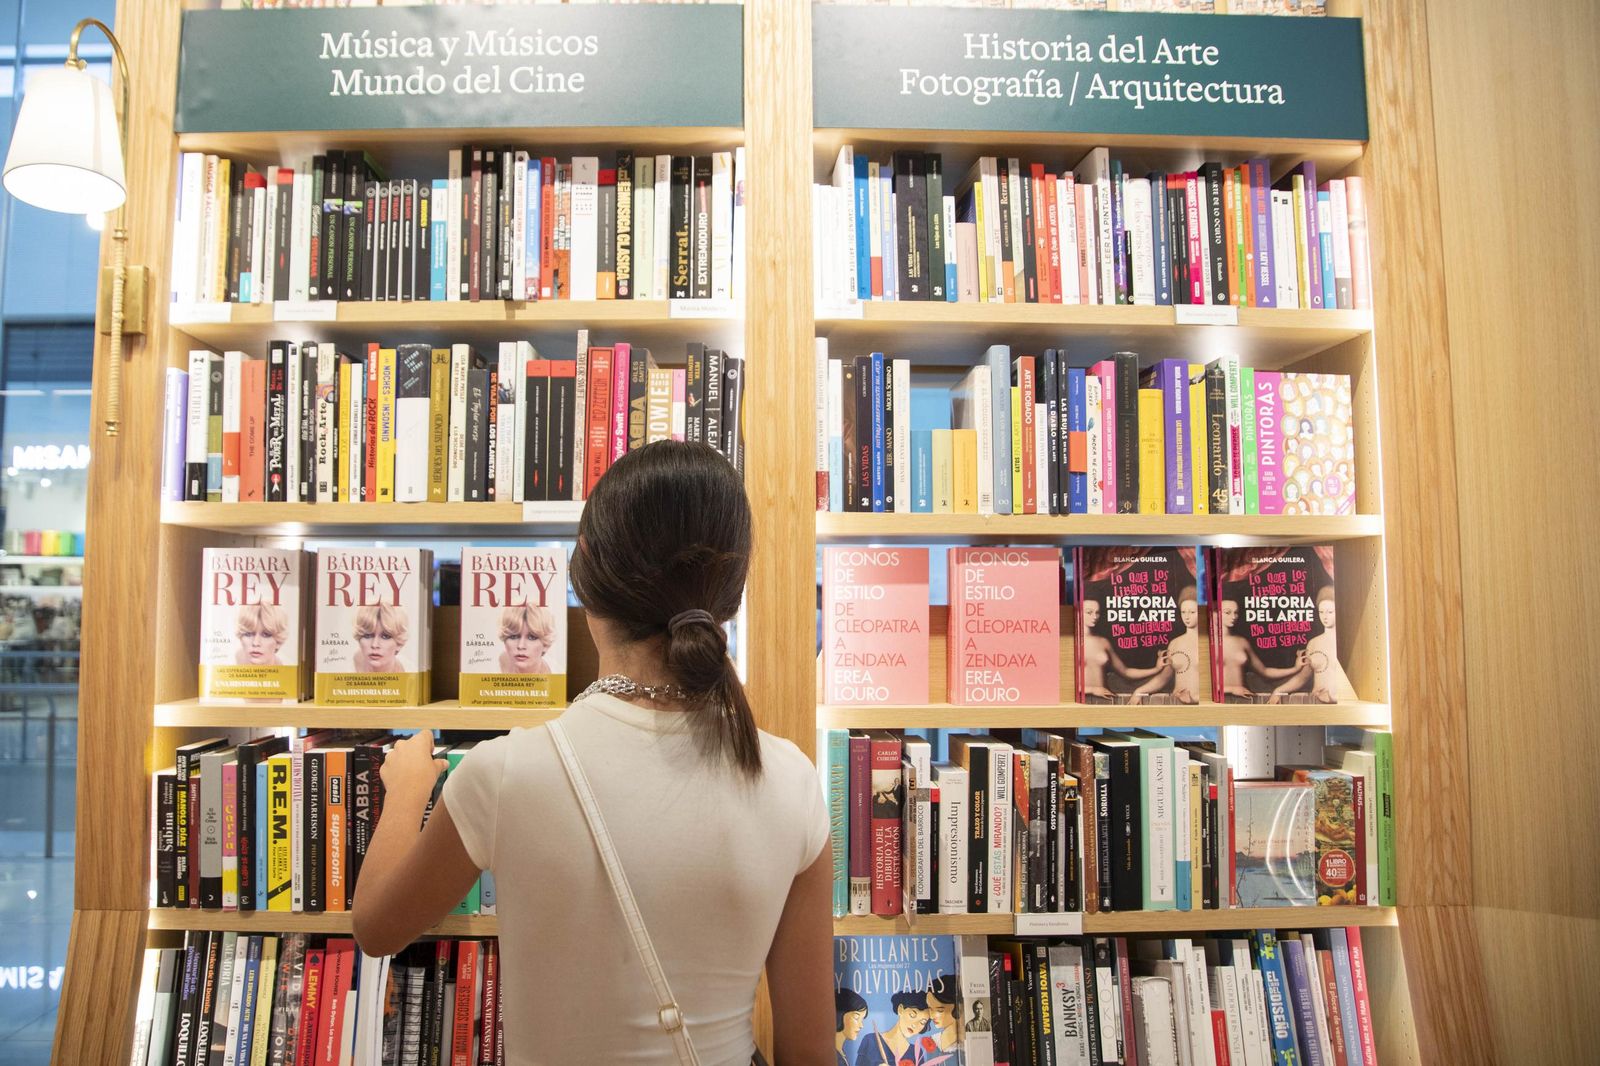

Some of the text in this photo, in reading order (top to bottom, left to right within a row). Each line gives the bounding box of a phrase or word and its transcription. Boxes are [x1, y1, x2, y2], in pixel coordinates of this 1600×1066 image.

[319, 28, 599, 67] Música y Músicos
[964, 32, 1220, 64] Historia del Arte
[329, 64, 586, 97] Mundo del Cine
[899, 67, 1062, 105] Fotografía
[1086, 73, 1284, 108] Arquitectura
[698, 212, 708, 286] EXTREMODURO
[368, 398, 377, 422] ROCK
[1050, 400, 1056, 408] EL
[318, 402, 328, 464] Rock Arte
[368, 423, 376, 435] del
[1258, 382, 1276, 466] PINTORAS
[1212, 412, 1226, 476] Leonardo
[212, 553, 290, 572] BÁRBARA
[327, 553, 411, 572] BÁRBARA
[472, 553, 557, 572] BÁRBARA
[834, 552, 900, 566] ICONOS
[965, 552, 1030, 566] ICONOS
[834, 568, 854, 584] DE
[966, 568, 984, 584] DE
[1128, 571, 1149, 584] QUE
[1154, 569, 1170, 582] LOS
[1266, 571, 1287, 584] QUE
[1292, 569, 1308, 582] LOS
[212, 572, 290, 606] REY
[326, 572, 411, 606] REY
[472, 572, 558, 607] REY
[834, 585, 886, 600] ESTILO
[966, 585, 1016, 600] ESTILO
[1152, 581, 1168, 594] DE
[1290, 581, 1306, 594] DE
[834, 602, 854, 617] DE
[966, 602, 985, 617] DE
[1106, 596, 1177, 609] HISTORIA
[1244, 596, 1315, 609] HISTORIA
[1107, 609, 1176, 622] DEL ARTE
[1245, 609, 1314, 622] DEL ARTE
[834, 619, 920, 634] CLEOPATRA
[965, 619, 1051, 634] CLEOPATRA
[834, 636, 846, 650] A
[965, 637, 977, 650] A
[1117, 634, 1169, 648] QUE SEPAS
[1256, 634, 1308, 649] QUE SEPAS
[834, 653, 907, 667] ZENDAYA
[965, 653, 1037, 668] ZENDAYA
[834, 670, 873, 685] EREA
[966, 670, 1004, 685] EREA
[834, 686, 890, 702] LOURO
[966, 686, 1020, 702] LOURO
[997, 754, 1006, 800] WILL GOMPERTZ
[273, 764, 287, 844] R.E.M.
[356, 770, 369, 822] ABBA
[1100, 784, 1108, 817] SOROLLA
[164, 813, 174, 853] Sabina
[179, 827, 188, 847] DÍAZ
[884, 826, 892, 838] LA
[330, 814, 342, 887] supersonic
[948, 800, 961, 884] Impresionismo
[992, 806, 1002, 896] ¿QUÉ ESTÁS MIRANDO?
[884, 850, 894, 881] DIBUJO
[890, 826, 900, 888] ILUSTRACIÓN
[876, 846, 884, 890] HISTORIA
[840, 938, 940, 962] BRILLANTES
[306, 969, 318, 1009] LEMMY
[834, 969, 945, 994] Y OLVIDADAS
[1039, 962, 1051, 1034] YAYOI KUSAMA
[455, 985, 470, 1054] MARTIN SCORSESE
[1062, 988, 1078, 1038] BANKSY
[1272, 992, 1290, 1038] DISEÑO
